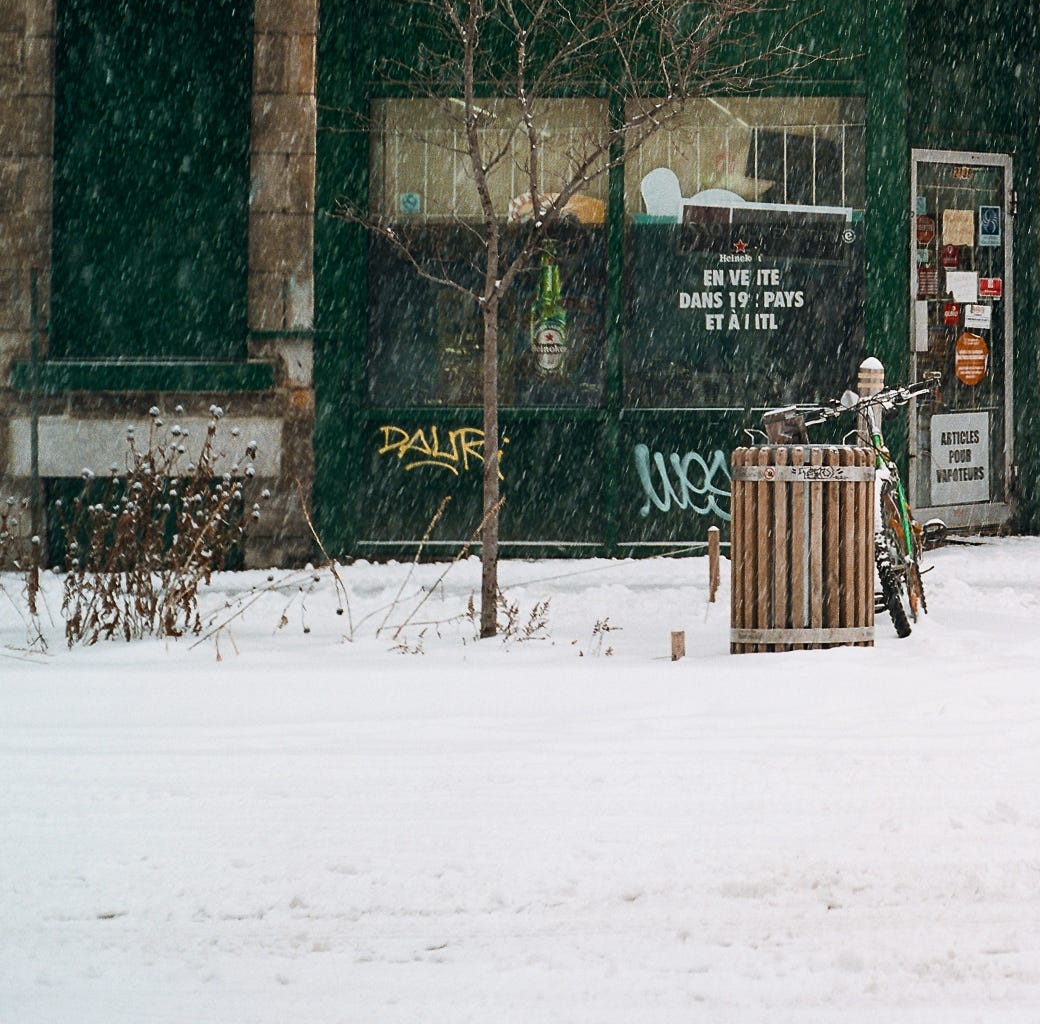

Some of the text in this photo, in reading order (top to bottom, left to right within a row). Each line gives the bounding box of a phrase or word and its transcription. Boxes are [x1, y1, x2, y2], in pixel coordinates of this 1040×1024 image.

[719, 253, 762, 263] Heinek
[703, 269, 724, 287] EN
[679, 290, 804, 309] DANS 19 PAYS
[705, 313, 724, 331] ET
[728, 309, 740, 331] À
[941, 430, 979, 446] ARTICLES
[949, 449, 971, 463] POUR
[936, 466, 985, 483] VAPOTEURS
